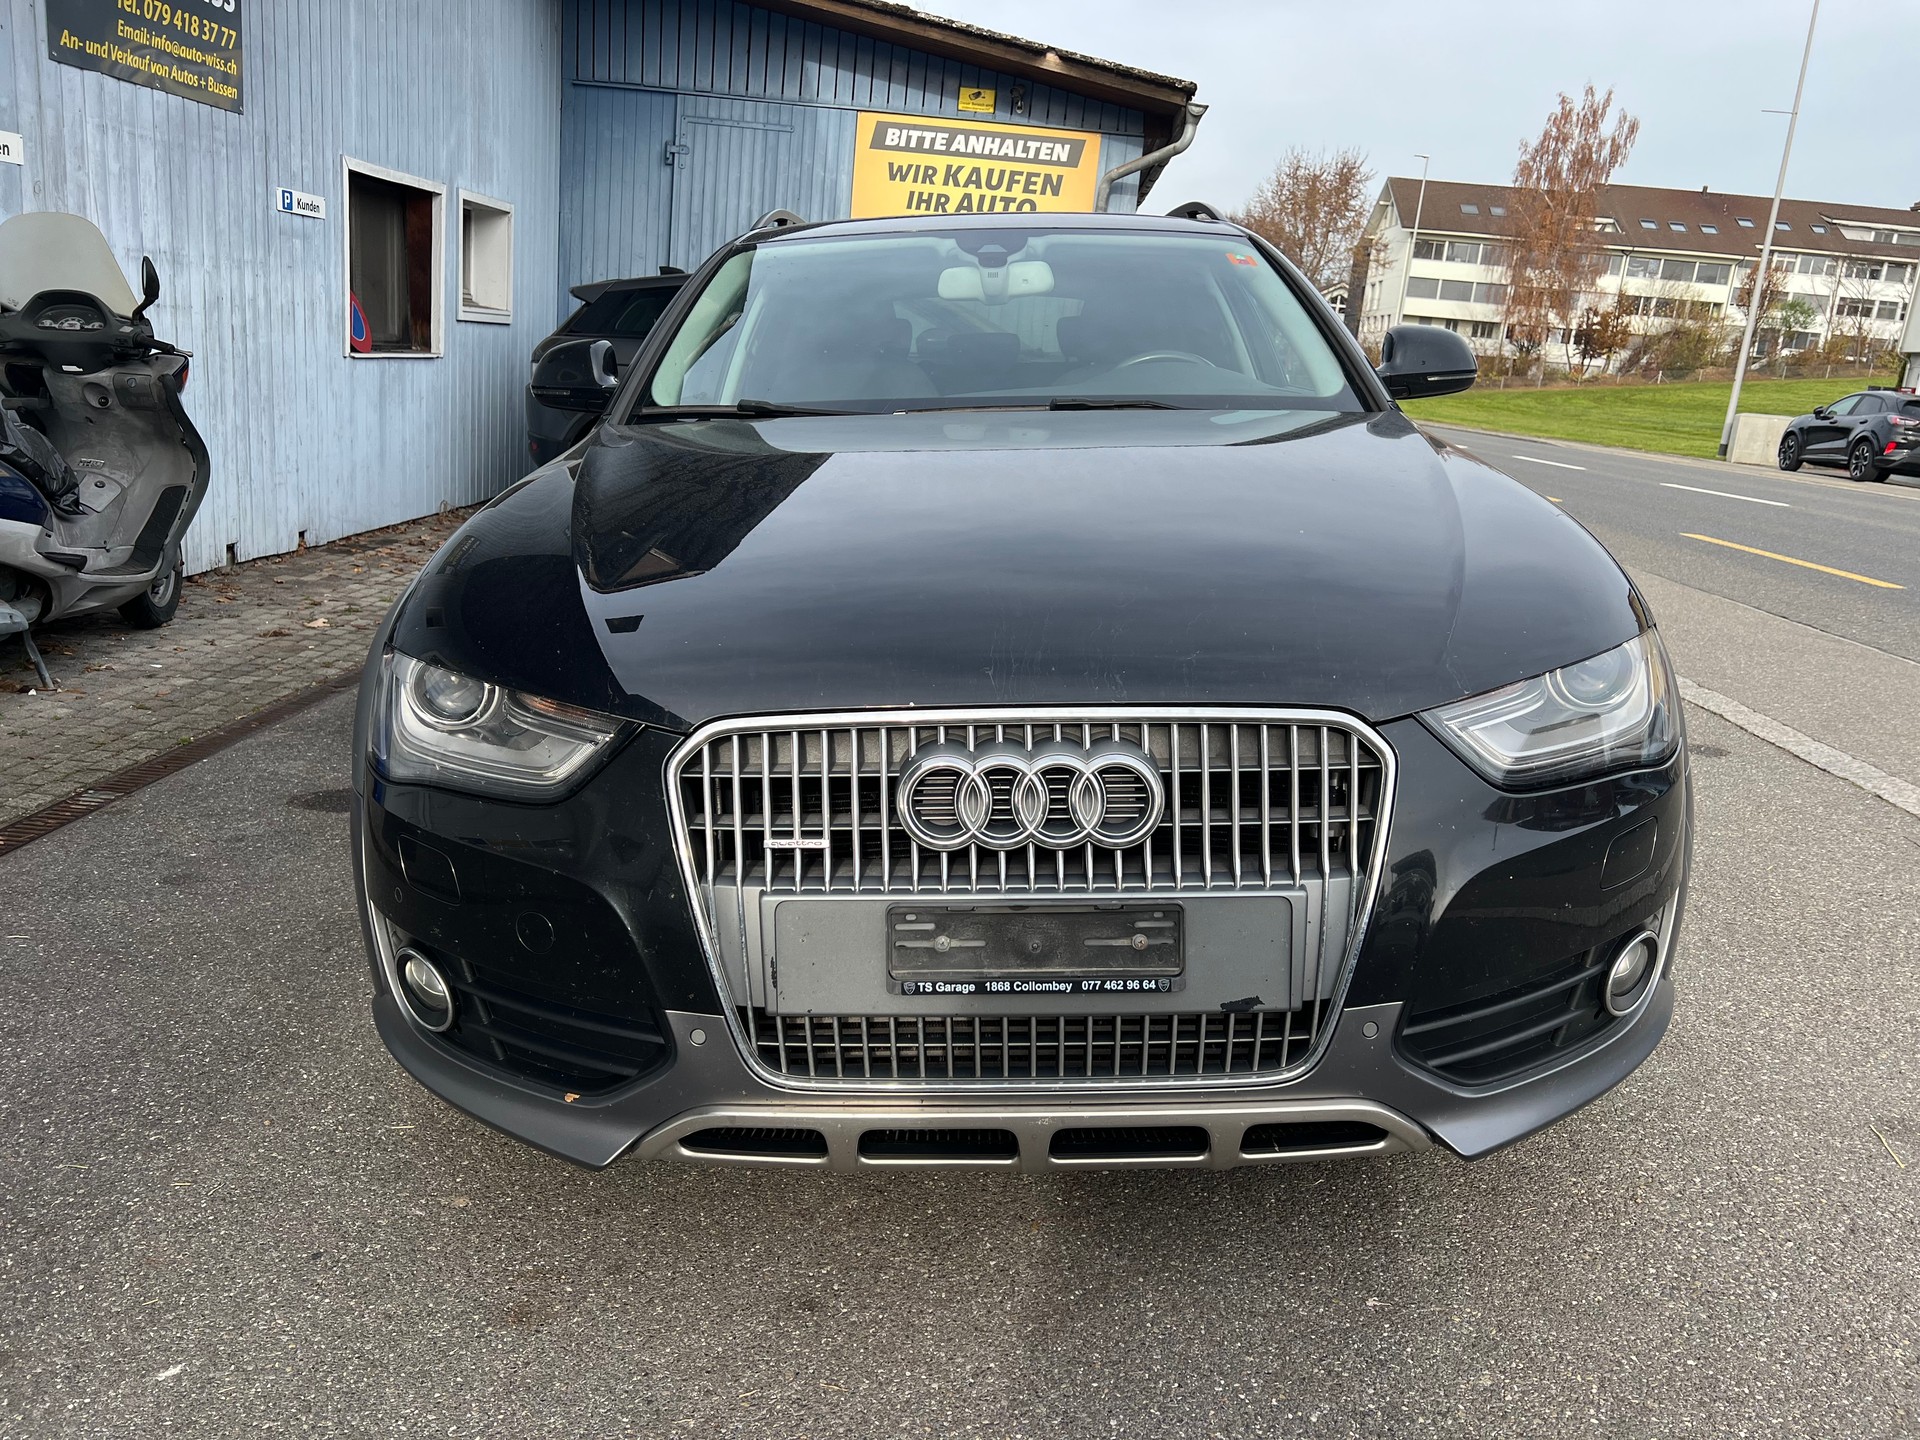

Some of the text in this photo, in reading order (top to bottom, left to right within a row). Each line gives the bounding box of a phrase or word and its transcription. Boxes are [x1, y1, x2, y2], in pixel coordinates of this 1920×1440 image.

[144, 0, 171, 26] 079
[173, 9, 199, 36] 418
[201, 19, 218, 43] 37
[221, 26, 237, 50] 77
[60, 29, 84, 50] An-
[86, 40, 108, 58] und
[110, 43, 150, 72] Verkauf
[150, 61, 169, 78] von
[170, 65, 199, 87] Autos
[208, 76, 238, 99] Bussen
[117, 19, 238, 76] Email: info@auto-wiss.ch
[884, 127, 1071, 162] BITTE ANHALTEN
[887, 162, 1064, 197] WIR KAUFEN
[296, 198, 320, 213] Kunden
[906, 190, 1037, 213] IHR AUTO
[918, 979, 1156, 994] TS Garage 1868 Collombey 077 462 96 64
